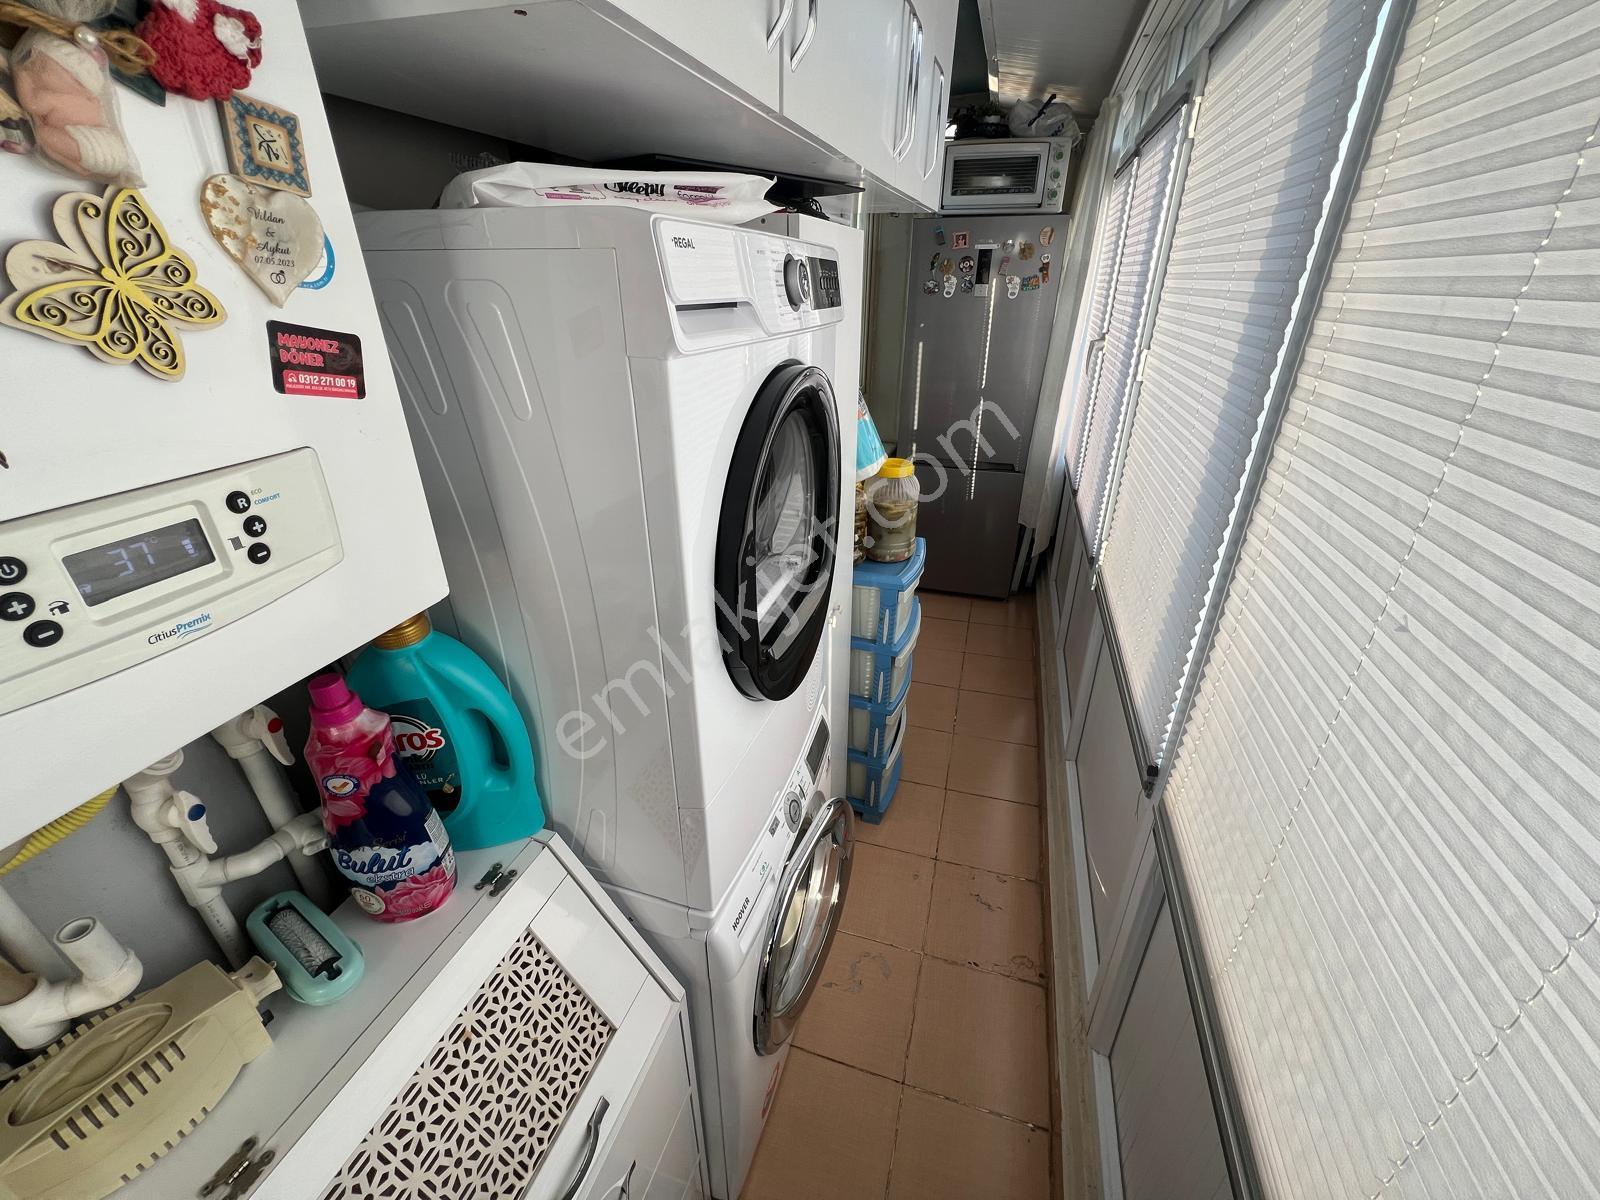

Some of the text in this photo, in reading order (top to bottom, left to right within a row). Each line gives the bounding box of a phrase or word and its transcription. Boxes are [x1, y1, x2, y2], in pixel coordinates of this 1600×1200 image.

[246, 206, 285, 224] Vildan
[265, 227, 276, 238] &
[256, 241, 291, 256] Aykut
[672, 236, 696, 249] REGAL
[254, 256, 295, 268] 07.05.2023
[277, 332, 340, 354] MAYONEZ
[279, 347, 325, 367] DÖNER
[298, 374, 320, 385] 0312
[320, 376, 334, 386] 271
[335, 378, 346, 387] 00
[347, 379, 356, 388] 19
[254, 492, 281, 505] COMFORT
[394, 728, 445, 752] ros
[337, 846, 413, 875] Bulut
[732, 897, 750, 931] HOOVER
